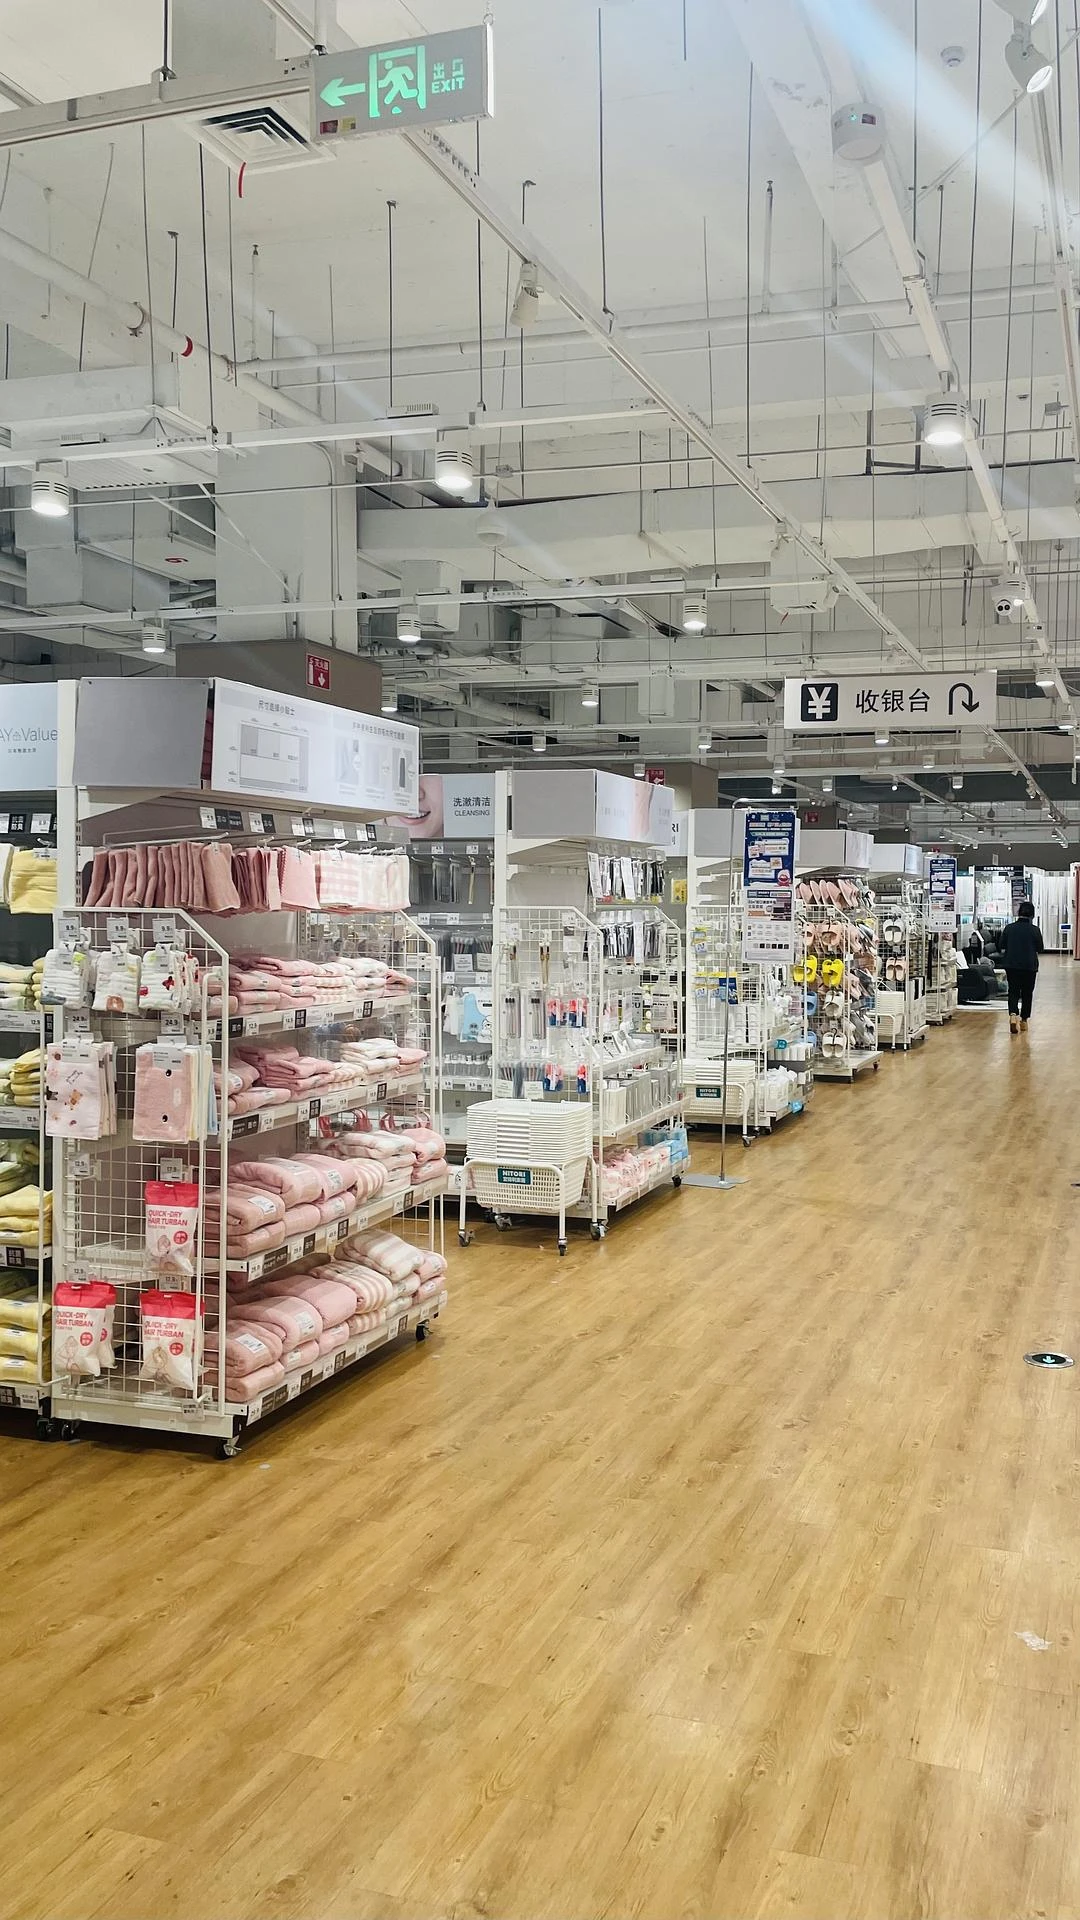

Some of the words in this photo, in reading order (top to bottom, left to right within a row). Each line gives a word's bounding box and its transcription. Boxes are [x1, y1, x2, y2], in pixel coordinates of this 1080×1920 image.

[433, 58, 464, 80] 出口
[431, 76, 465, 94] EXIT
[855, 688, 931, 714] 收银台
[20, 727, 58, 742] Value
[454, 809, 490, 817] CLEANSING
[502, 1170, 526, 1178] NITORI
[148, 1209, 183, 1219] QUICK-DRY
[161, 1218, 188, 1227] TURBAN
[68, 1318, 94, 1328] TURBAN
[144, 1320, 178, 1330] QUICK-DRY
[156, 1329, 184, 1338] TURBAN
